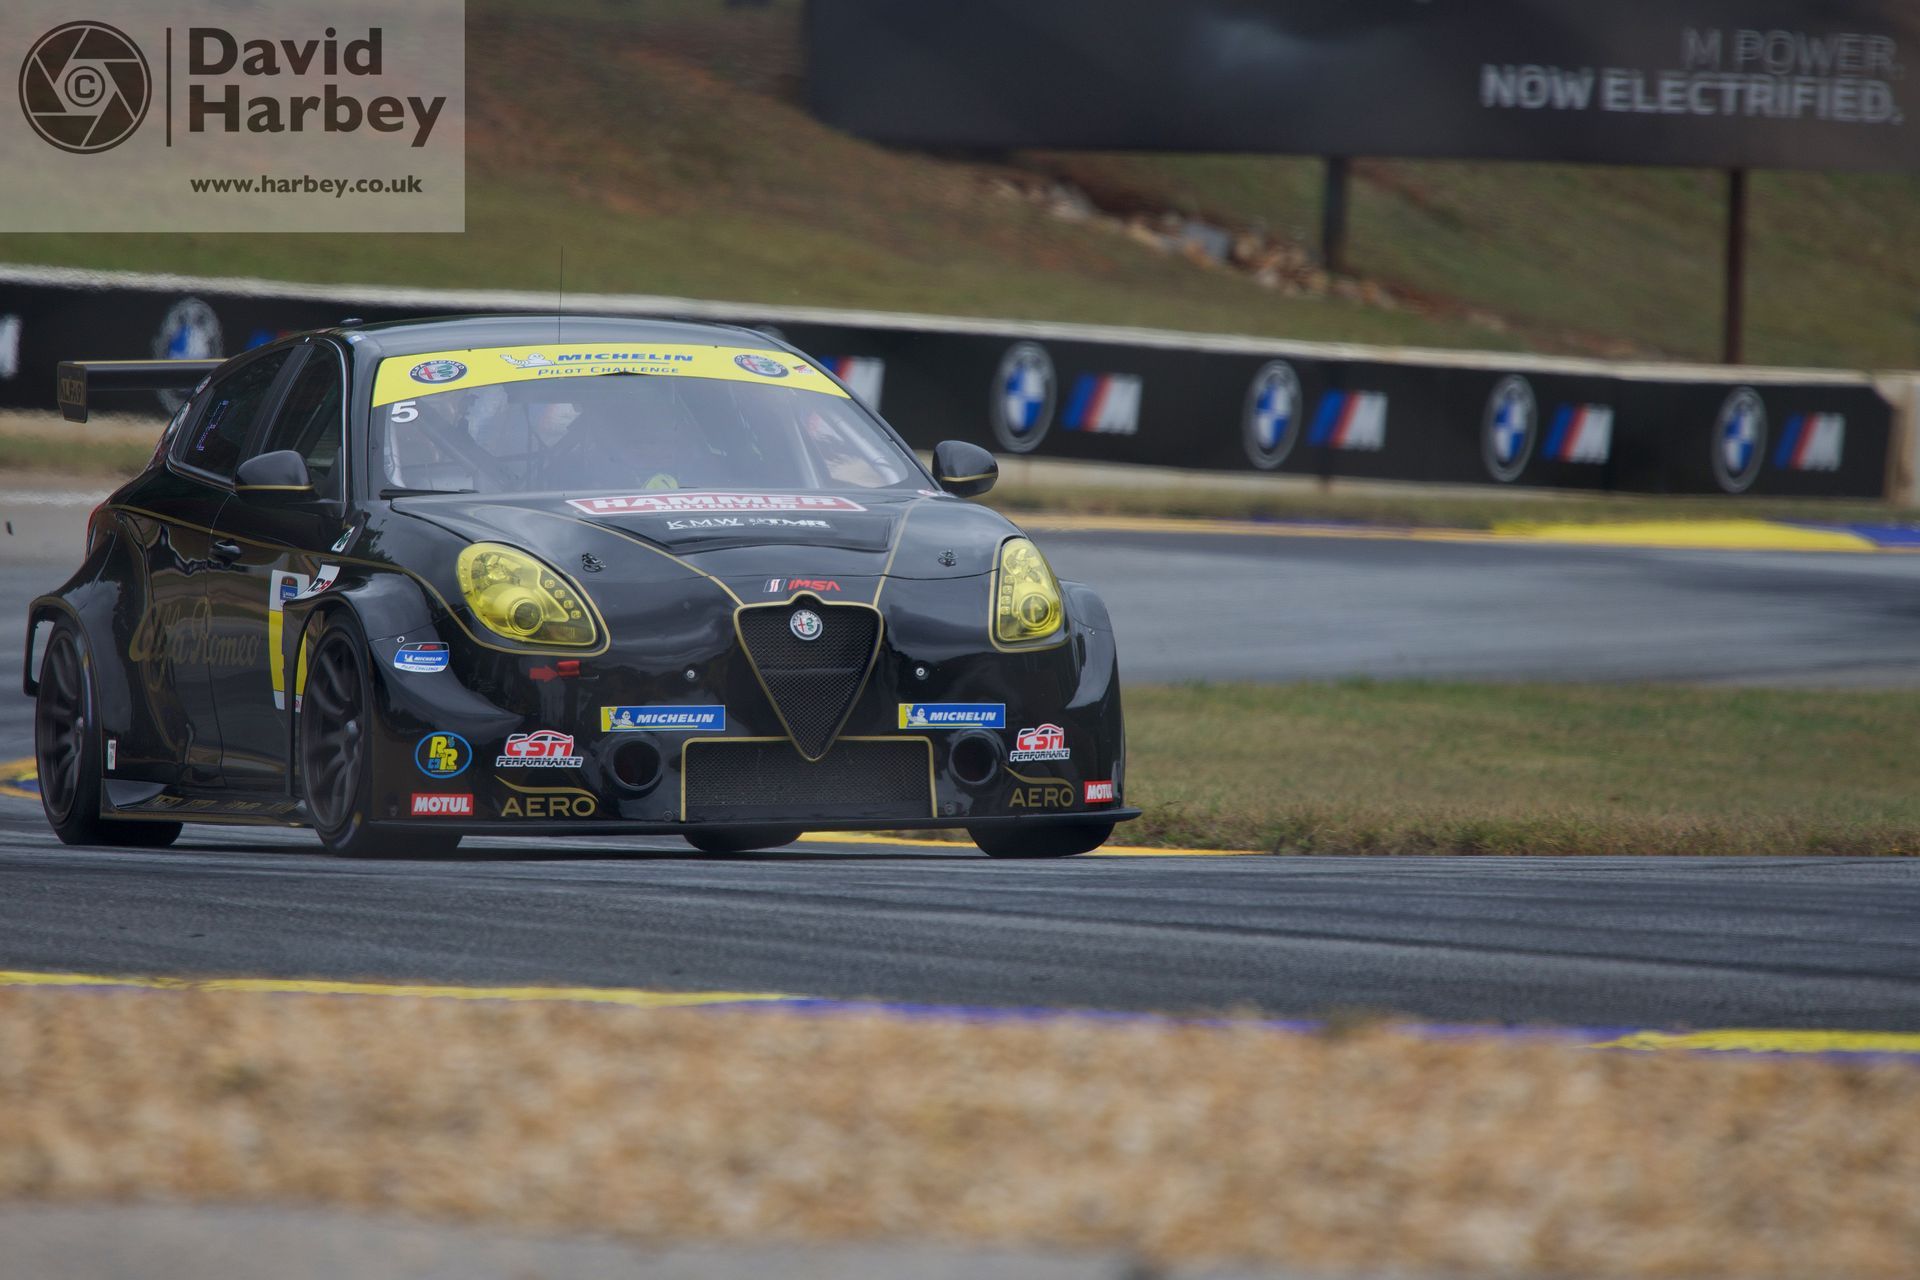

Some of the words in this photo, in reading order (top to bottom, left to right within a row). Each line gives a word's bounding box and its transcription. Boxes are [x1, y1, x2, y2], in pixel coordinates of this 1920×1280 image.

[1682, 28, 1722, 70] M
[1480, 64, 1595, 111] NOW
[558, 353, 694, 363] MICHELIN
[538, 367, 582, 376] PILOT
[590, 366, 680, 374] CHALLENGE
[391, 401, 419, 424] 5
[592, 495, 837, 509] HAMMER
[666, 518, 744, 530] KMW
[788, 579, 842, 592] IMSA
[636, 713, 715, 724] MICHELIN
[929, 711, 997, 722] MICHELIN
[1010, 748, 1070, 760] PERFORMANCE
[497, 757, 583, 768] PERFORMANCE
[1008, 787, 1075, 808] AERO
[413, 797, 472, 813] MOTUL
[500, 796, 596, 818] AERO
